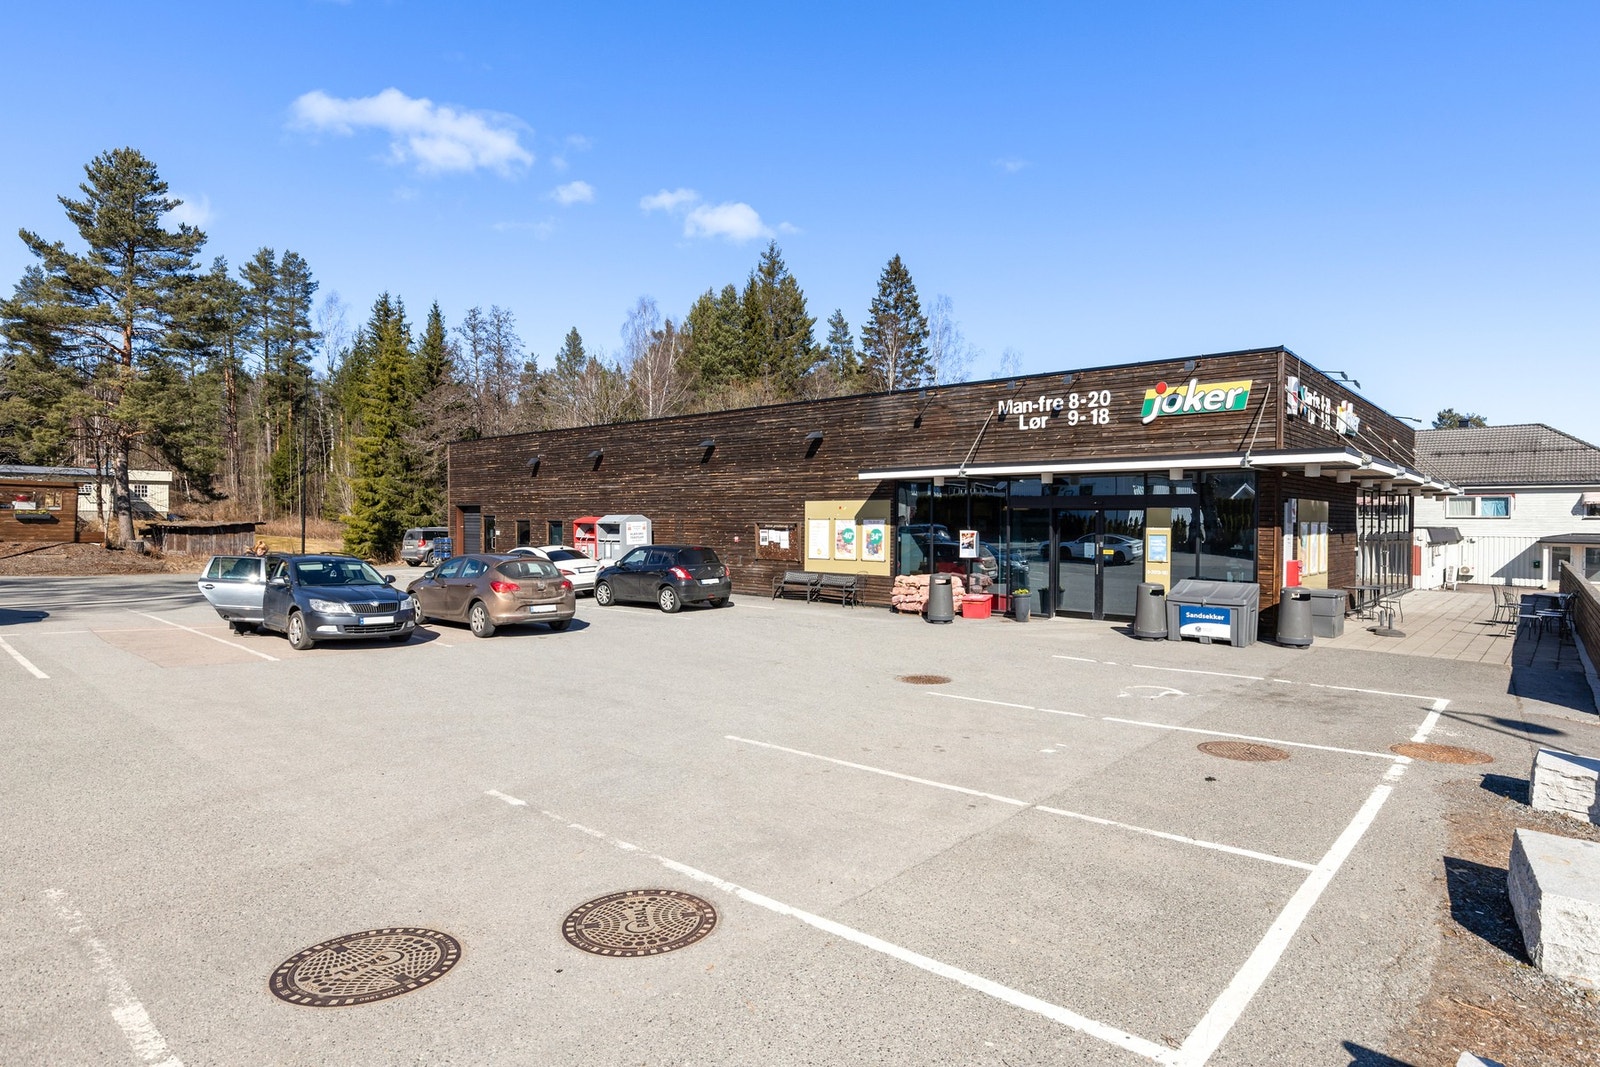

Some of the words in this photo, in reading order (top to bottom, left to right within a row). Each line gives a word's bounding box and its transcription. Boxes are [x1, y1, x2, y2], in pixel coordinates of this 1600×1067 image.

[998, 395, 1064, 415] Man-fre
[1068, 390, 1111, 409] 8-20
[1141, 378, 1244, 424] joker
[1019, 414, 1049, 430] Lør
[1067, 408, 1110, 426] 9-18
[1185, 611, 1225, 621] Sandsekker
[634, 907, 650, 928] BASAL
[332, 953, 391, 978] BASAL
